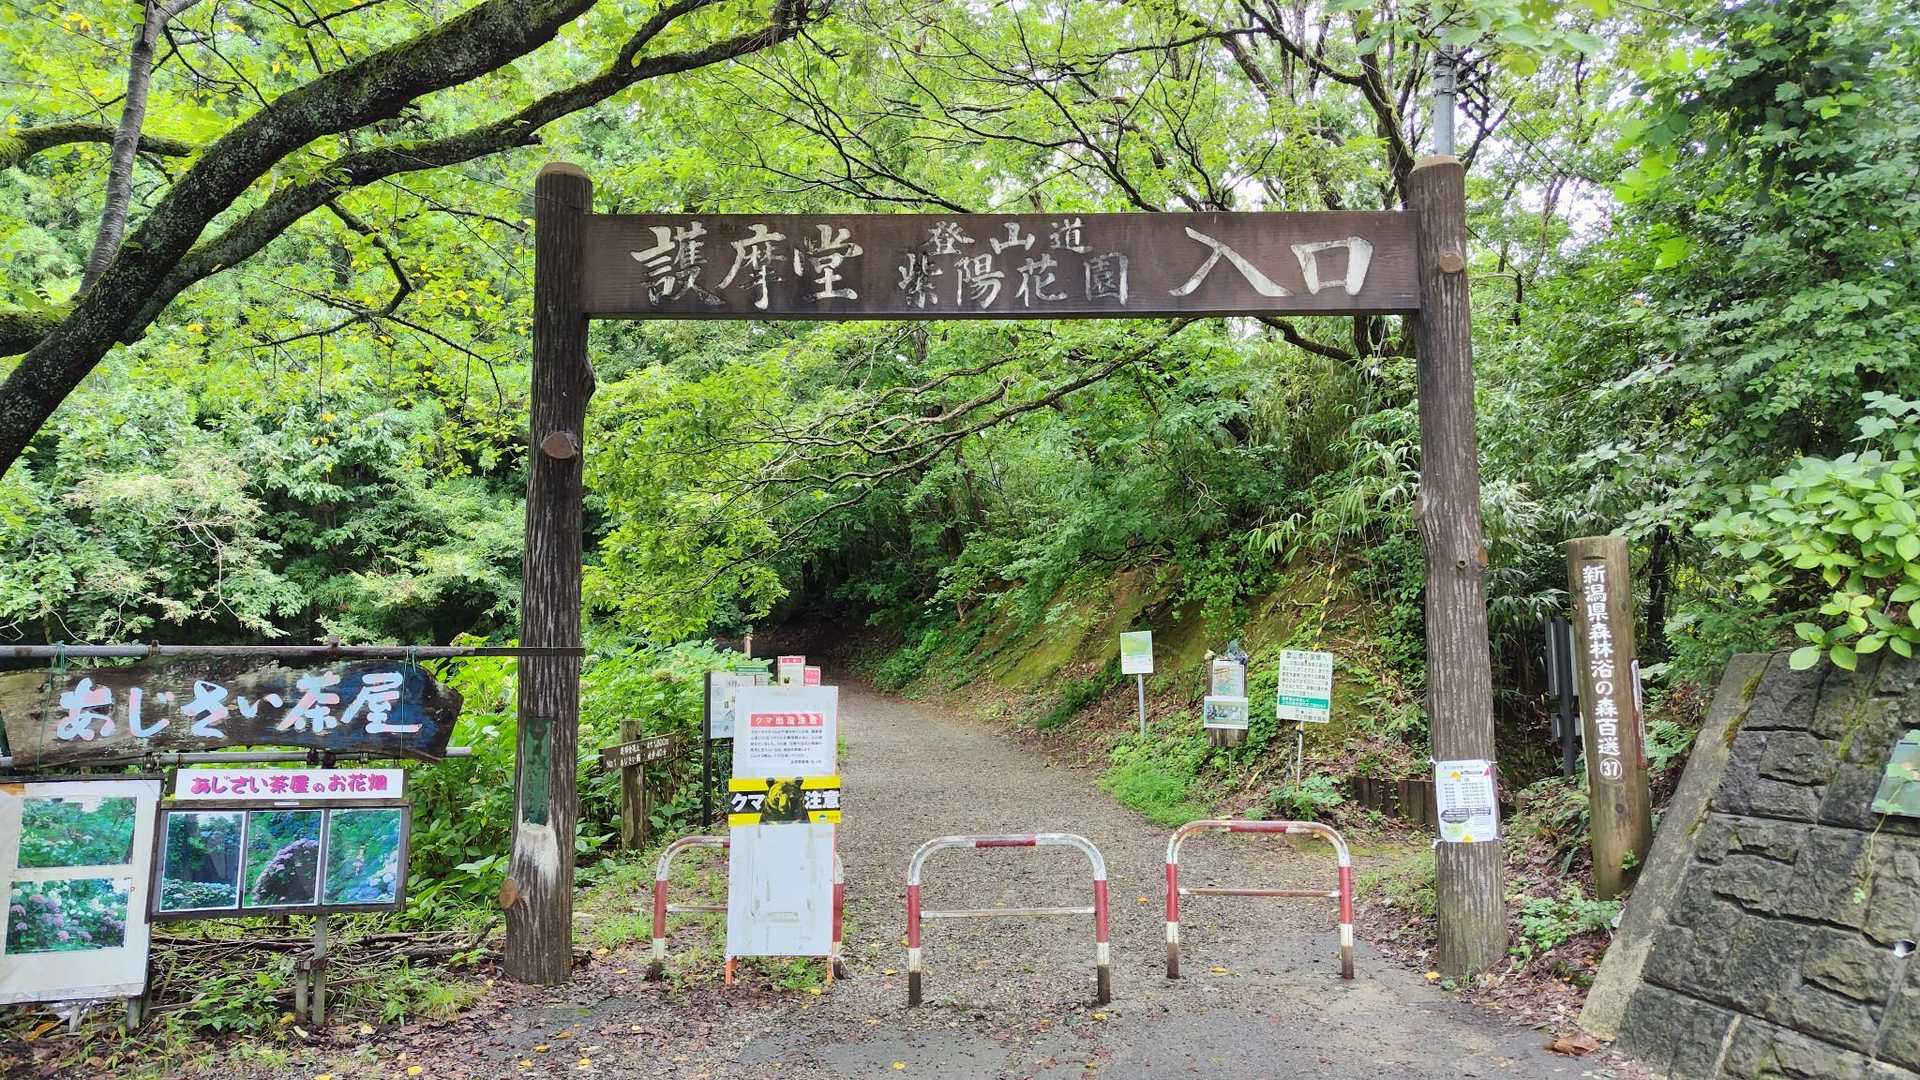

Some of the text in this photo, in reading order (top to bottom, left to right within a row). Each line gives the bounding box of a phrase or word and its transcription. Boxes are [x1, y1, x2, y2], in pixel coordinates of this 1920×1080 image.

[920, 217, 1092, 256] 登山道
[1168, 226, 1374, 297] 入口
[631, 221, 864, 310] 護摩堂
[898, 252, 1129, 309] 紫陽花園
[56, 673, 423, 740] あじさい茶屋
[190, 773, 389, 795] あじさい茶屋のお花畑
[731, 789, 840, 812] クマ 注意
